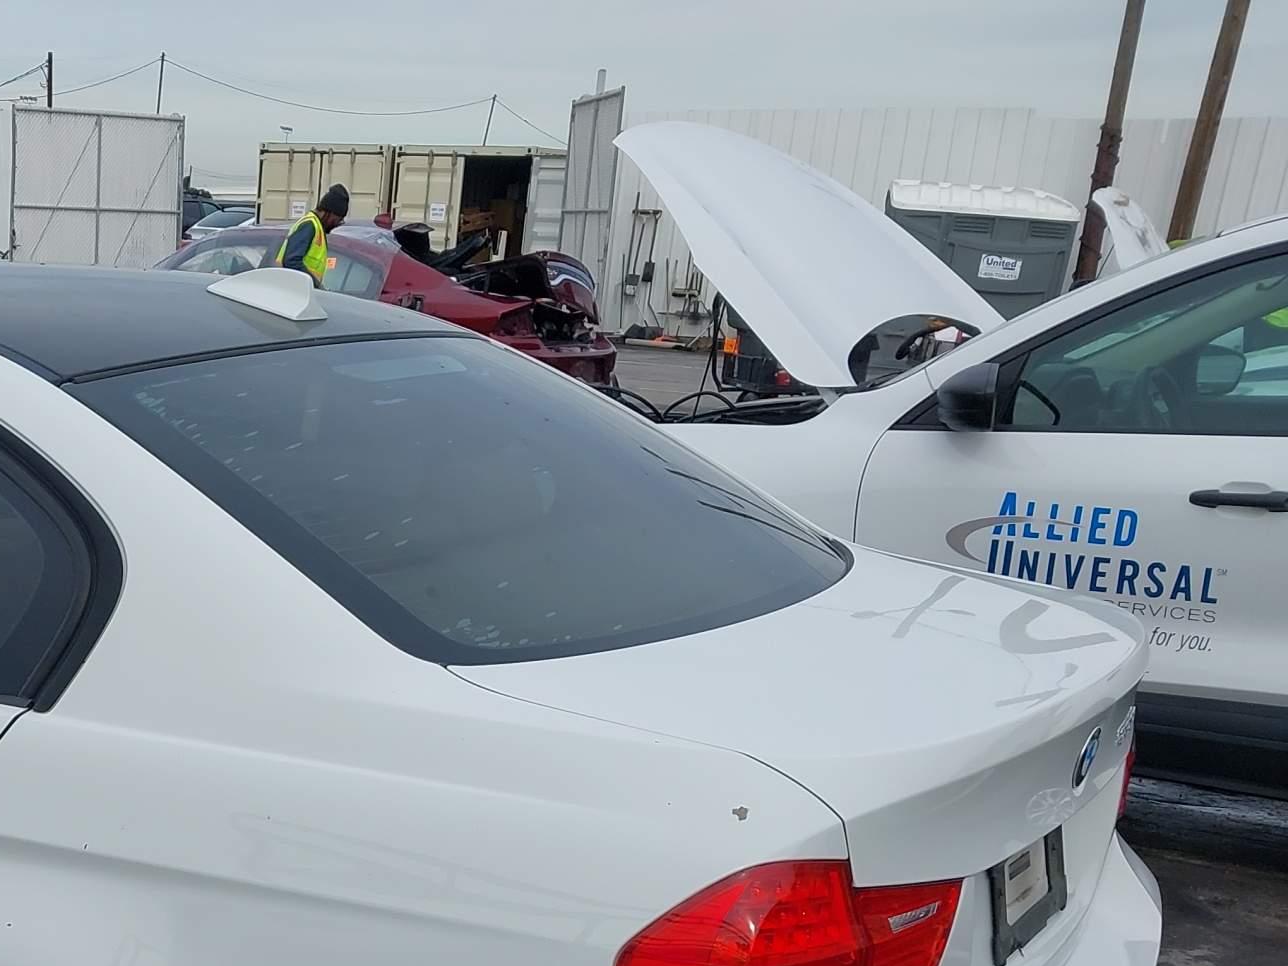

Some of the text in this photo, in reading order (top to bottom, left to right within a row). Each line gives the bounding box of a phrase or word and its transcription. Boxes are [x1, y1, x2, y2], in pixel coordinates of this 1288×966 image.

[986, 257, 1017, 268] United
[992, 491, 1139, 547] ALLIED
[986, 538, 1219, 605] UNIVERSAL
[1149, 626, 1213, 653] for you.
